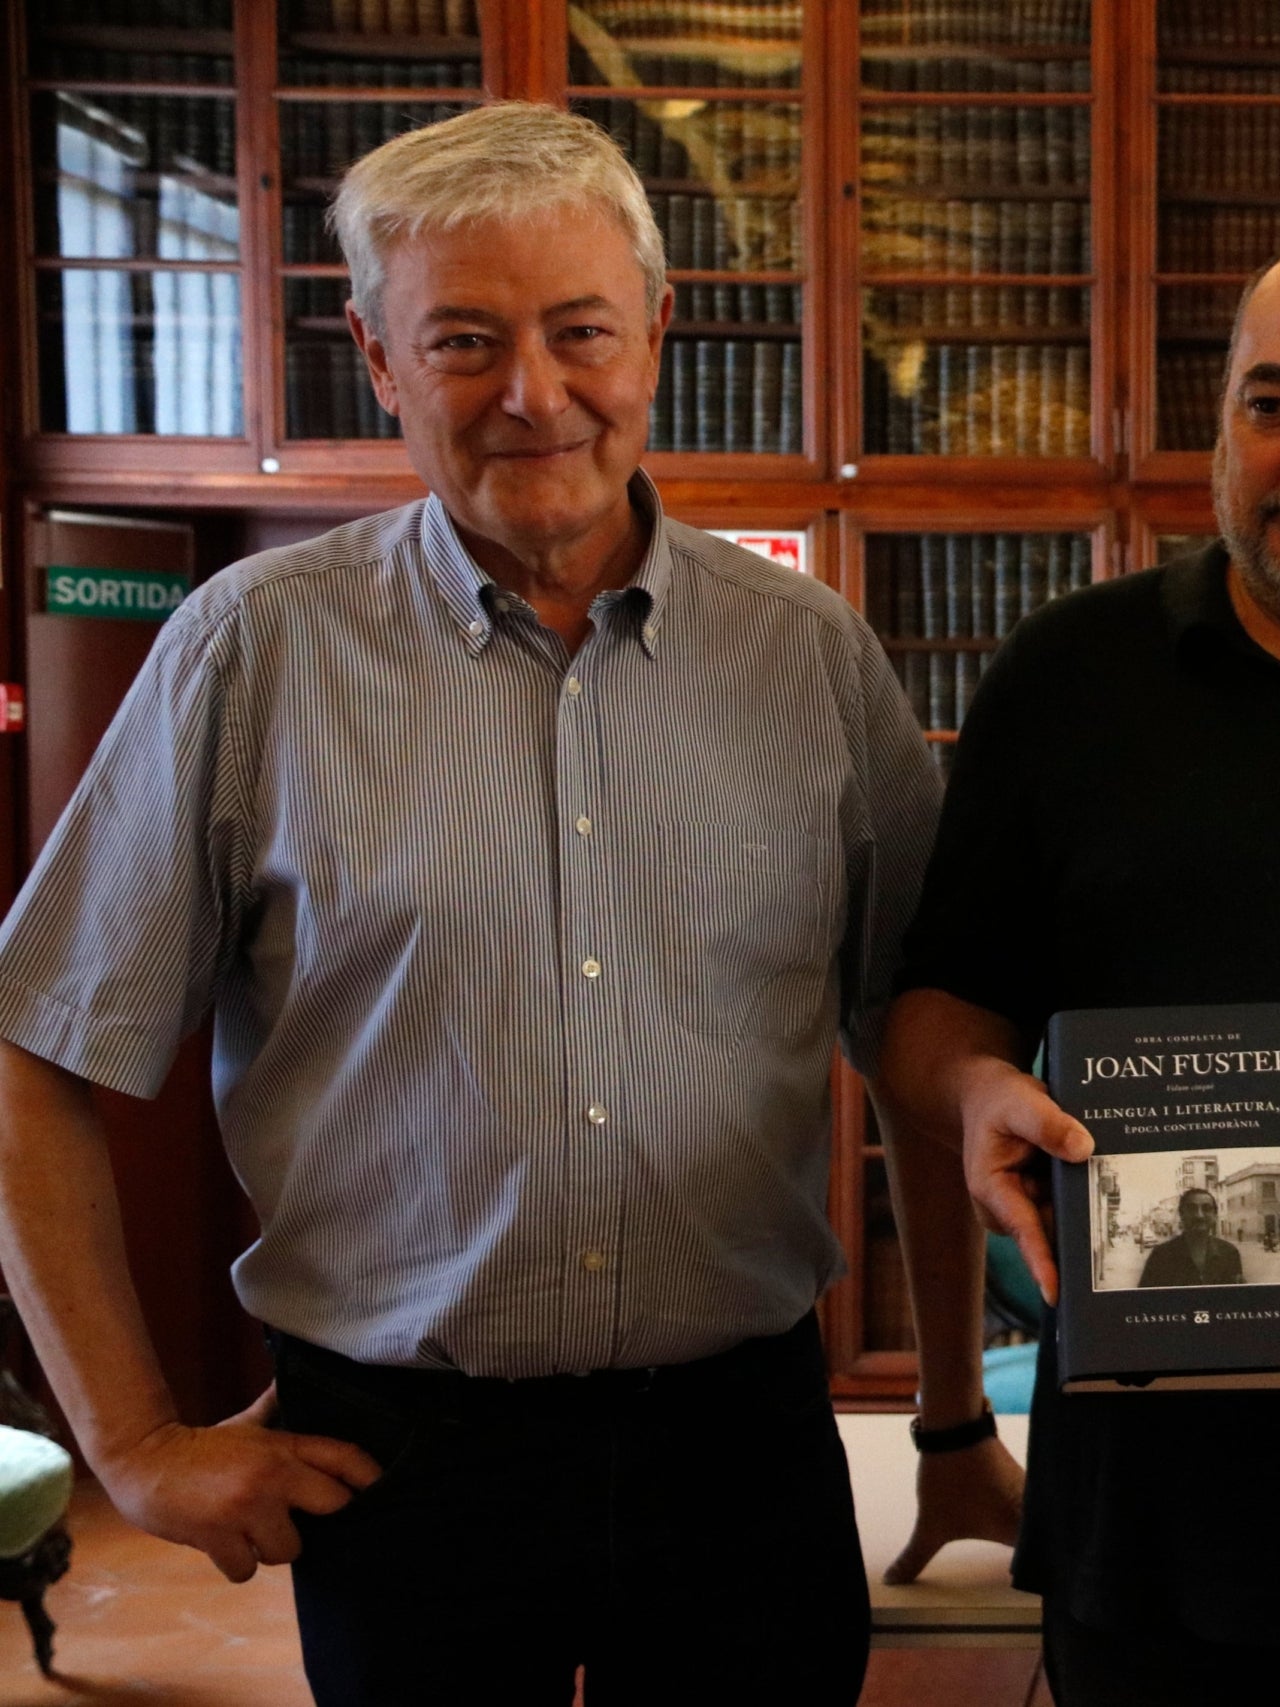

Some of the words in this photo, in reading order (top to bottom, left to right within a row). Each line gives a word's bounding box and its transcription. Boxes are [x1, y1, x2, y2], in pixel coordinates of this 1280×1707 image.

[55, 576, 184, 610] SORTIDA
[1135, 1033, 1162, 1044] OBRA
[1167, 1033, 1223, 1043] COMPLETA
[1228, 1033, 1241, 1041] DE
[1081, 1055, 1165, 1084] JOAN
[1084, 1106, 1158, 1120] LLENGUA
[1163, 1106, 1170, 1116] I
[1176, 1101, 1280, 1116] LITERATURA,
[1124, 1122, 1160, 1135] ÈPOCA
[1163, 1119, 1260, 1133] CONTEMPORÀNIA
[1125, 1312, 1187, 1324] CLÀSSICS
[1194, 1312, 1210, 1324] 62
[1215, 1311, 1280, 1321] CATALANS
